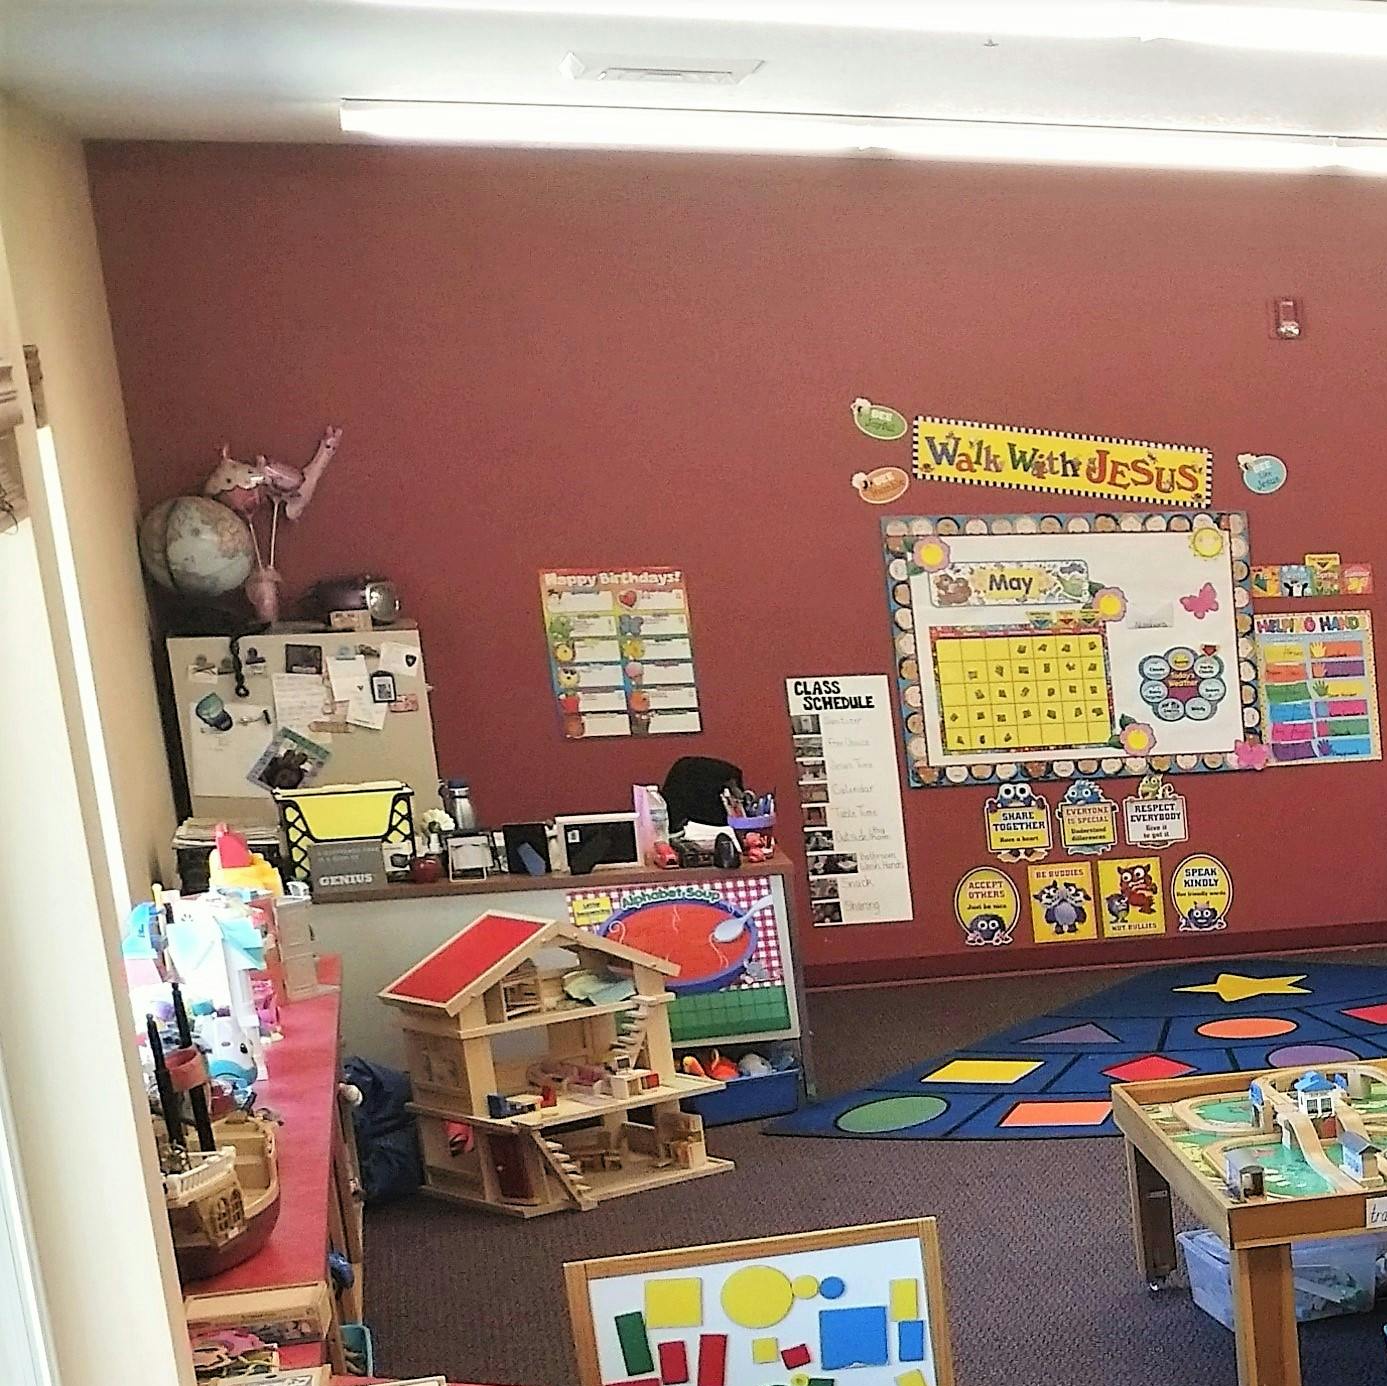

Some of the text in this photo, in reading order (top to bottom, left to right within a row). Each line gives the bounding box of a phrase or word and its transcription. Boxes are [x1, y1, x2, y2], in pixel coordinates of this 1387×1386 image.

[925, 432, 1201, 493] Walk With JESUS
[545, 571, 682, 587] Happy Birthdays!
[988, 572, 1034, 597] May
[794, 680, 841, 696] CLASS
[803, 696, 875, 711] SCHEDULE
[1066, 806, 1109, 815] EVERYONE
[1134, 803, 1176, 813] RESPECT
[1002, 811, 1034, 821] SHARE
[1077, 815, 1109, 824] SPECIAL
[1130, 812, 1181, 823] EVERYBODY
[992, 821, 1046, 832] TOGETHER
[1035, 868, 1084, 879] BE BUDDIES
[1185, 867, 1217, 877] SPEAK
[319, 873, 373, 886] GENIUS
[968, 880, 1004, 890] ACCEPT
[1183, 877, 1219, 888] KINDLY
[622, 887, 720, 908] Alphabet Soup
[968, 889, 1005, 899] OTHERS
[1111, 920, 1157, 932] NOT BULLIES
